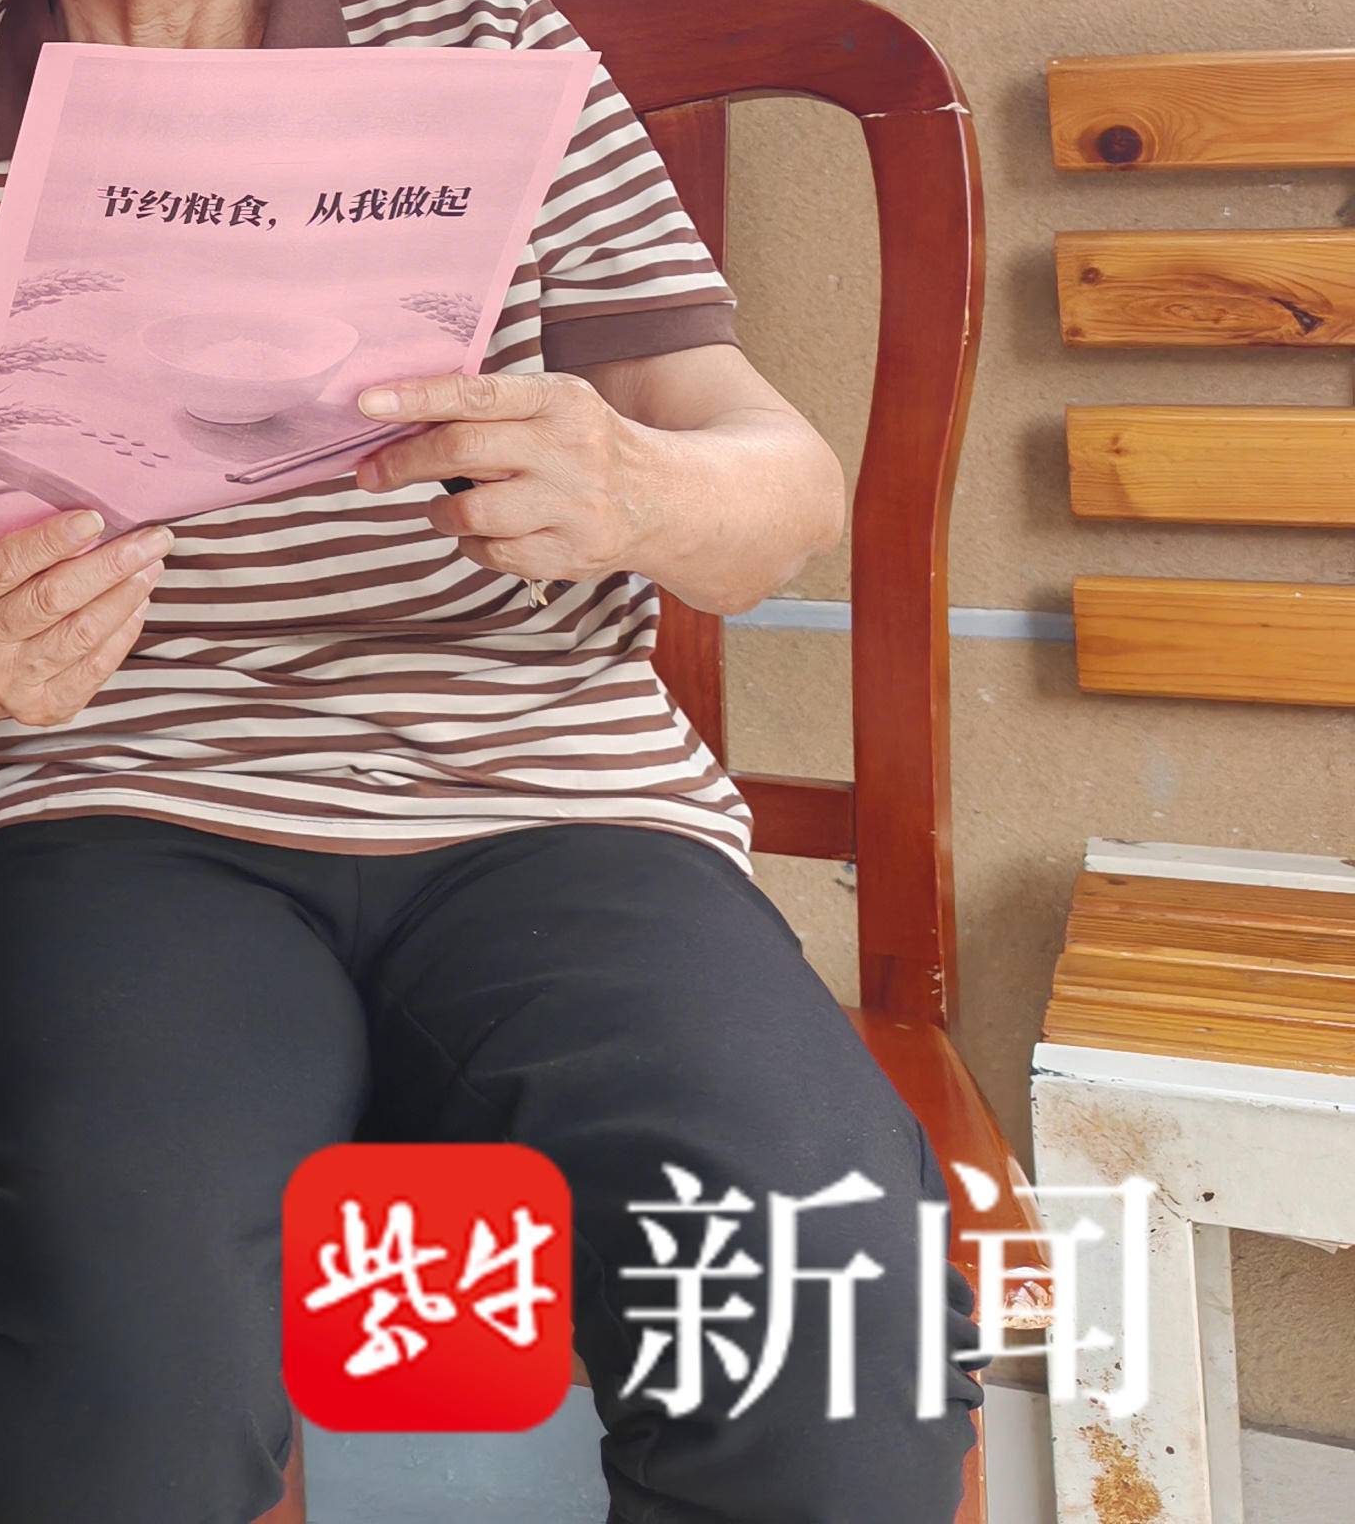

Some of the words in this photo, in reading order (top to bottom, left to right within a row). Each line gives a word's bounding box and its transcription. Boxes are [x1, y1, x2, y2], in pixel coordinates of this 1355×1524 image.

[95, 184, 473, 231] 节约粮食，从我做起
